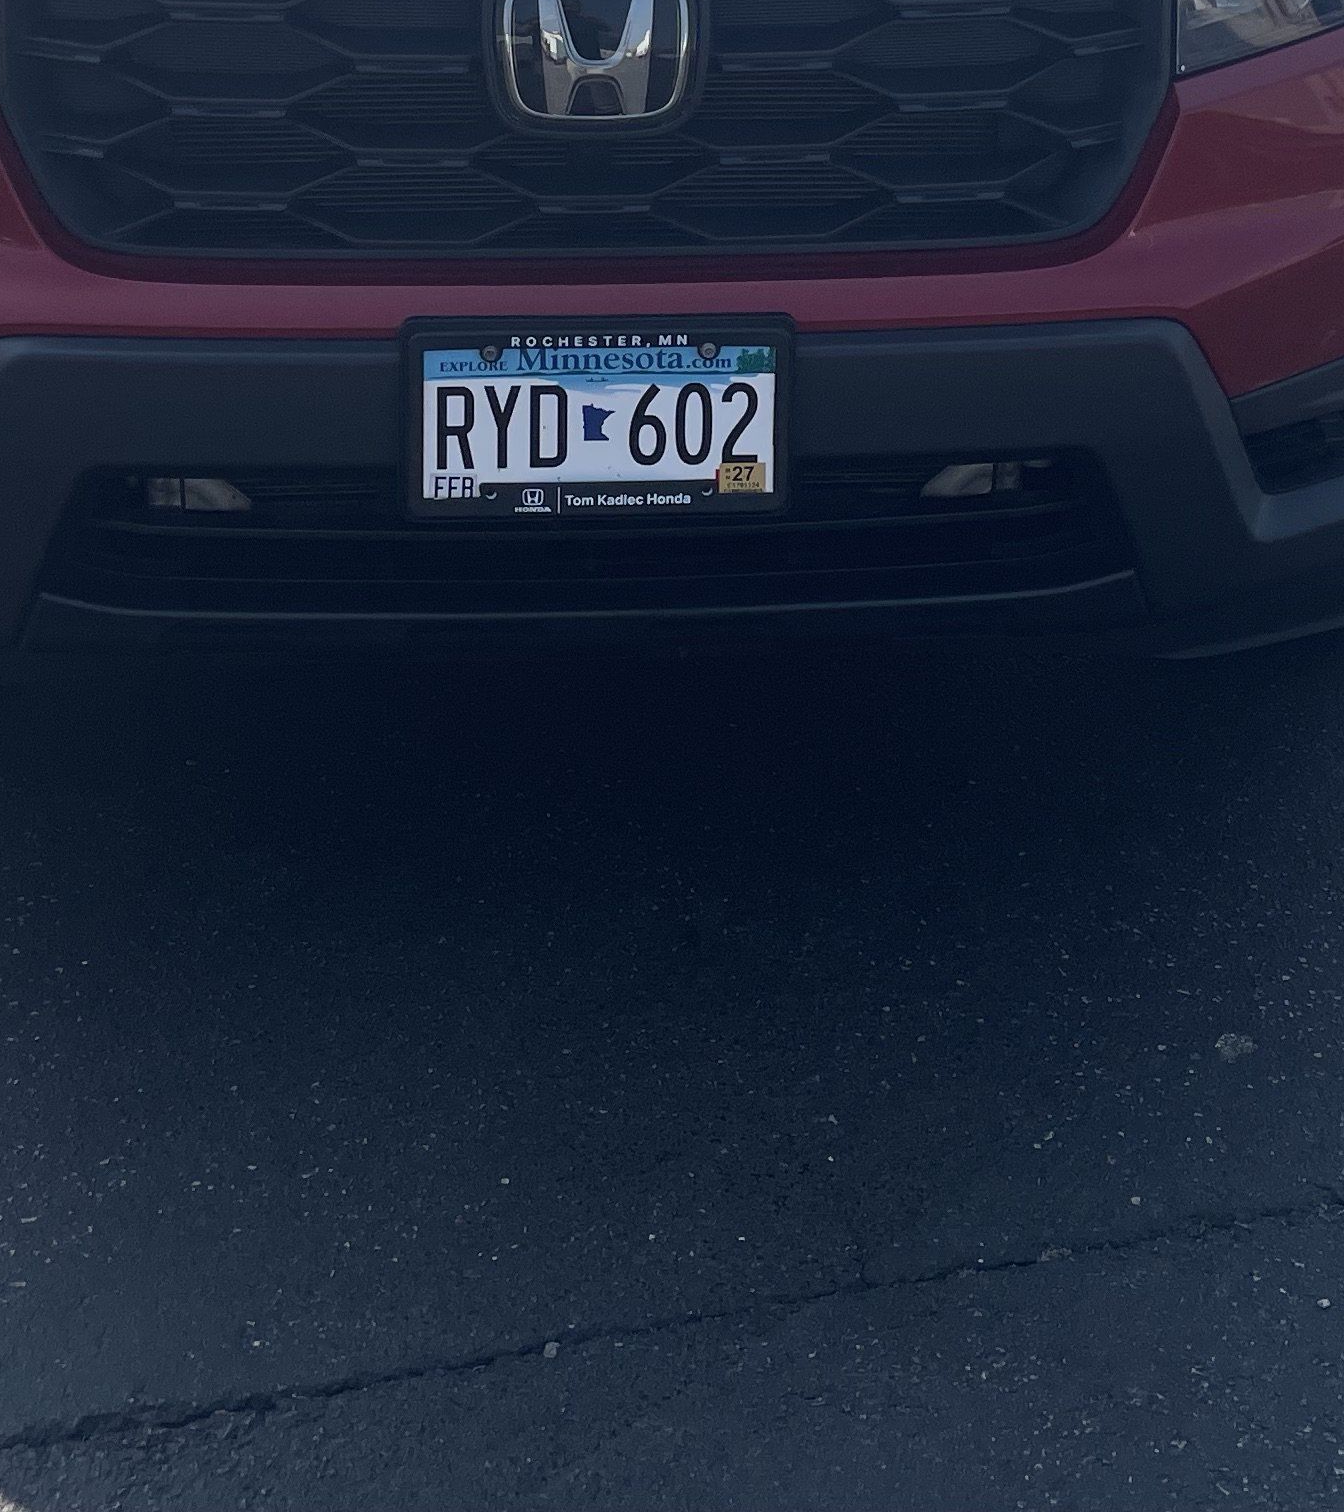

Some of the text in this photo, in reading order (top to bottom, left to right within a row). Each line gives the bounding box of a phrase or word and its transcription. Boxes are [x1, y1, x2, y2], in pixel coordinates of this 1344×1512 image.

[511, 334, 688, 348] ROCHESTER, MN
[440, 348, 732, 373] EXPLORE Minnesota.com
[436, 382, 759, 470] RYD 602
[732, 466, 754, 481] 27
[565, 491, 692, 506] Tom Kadlec Honda
